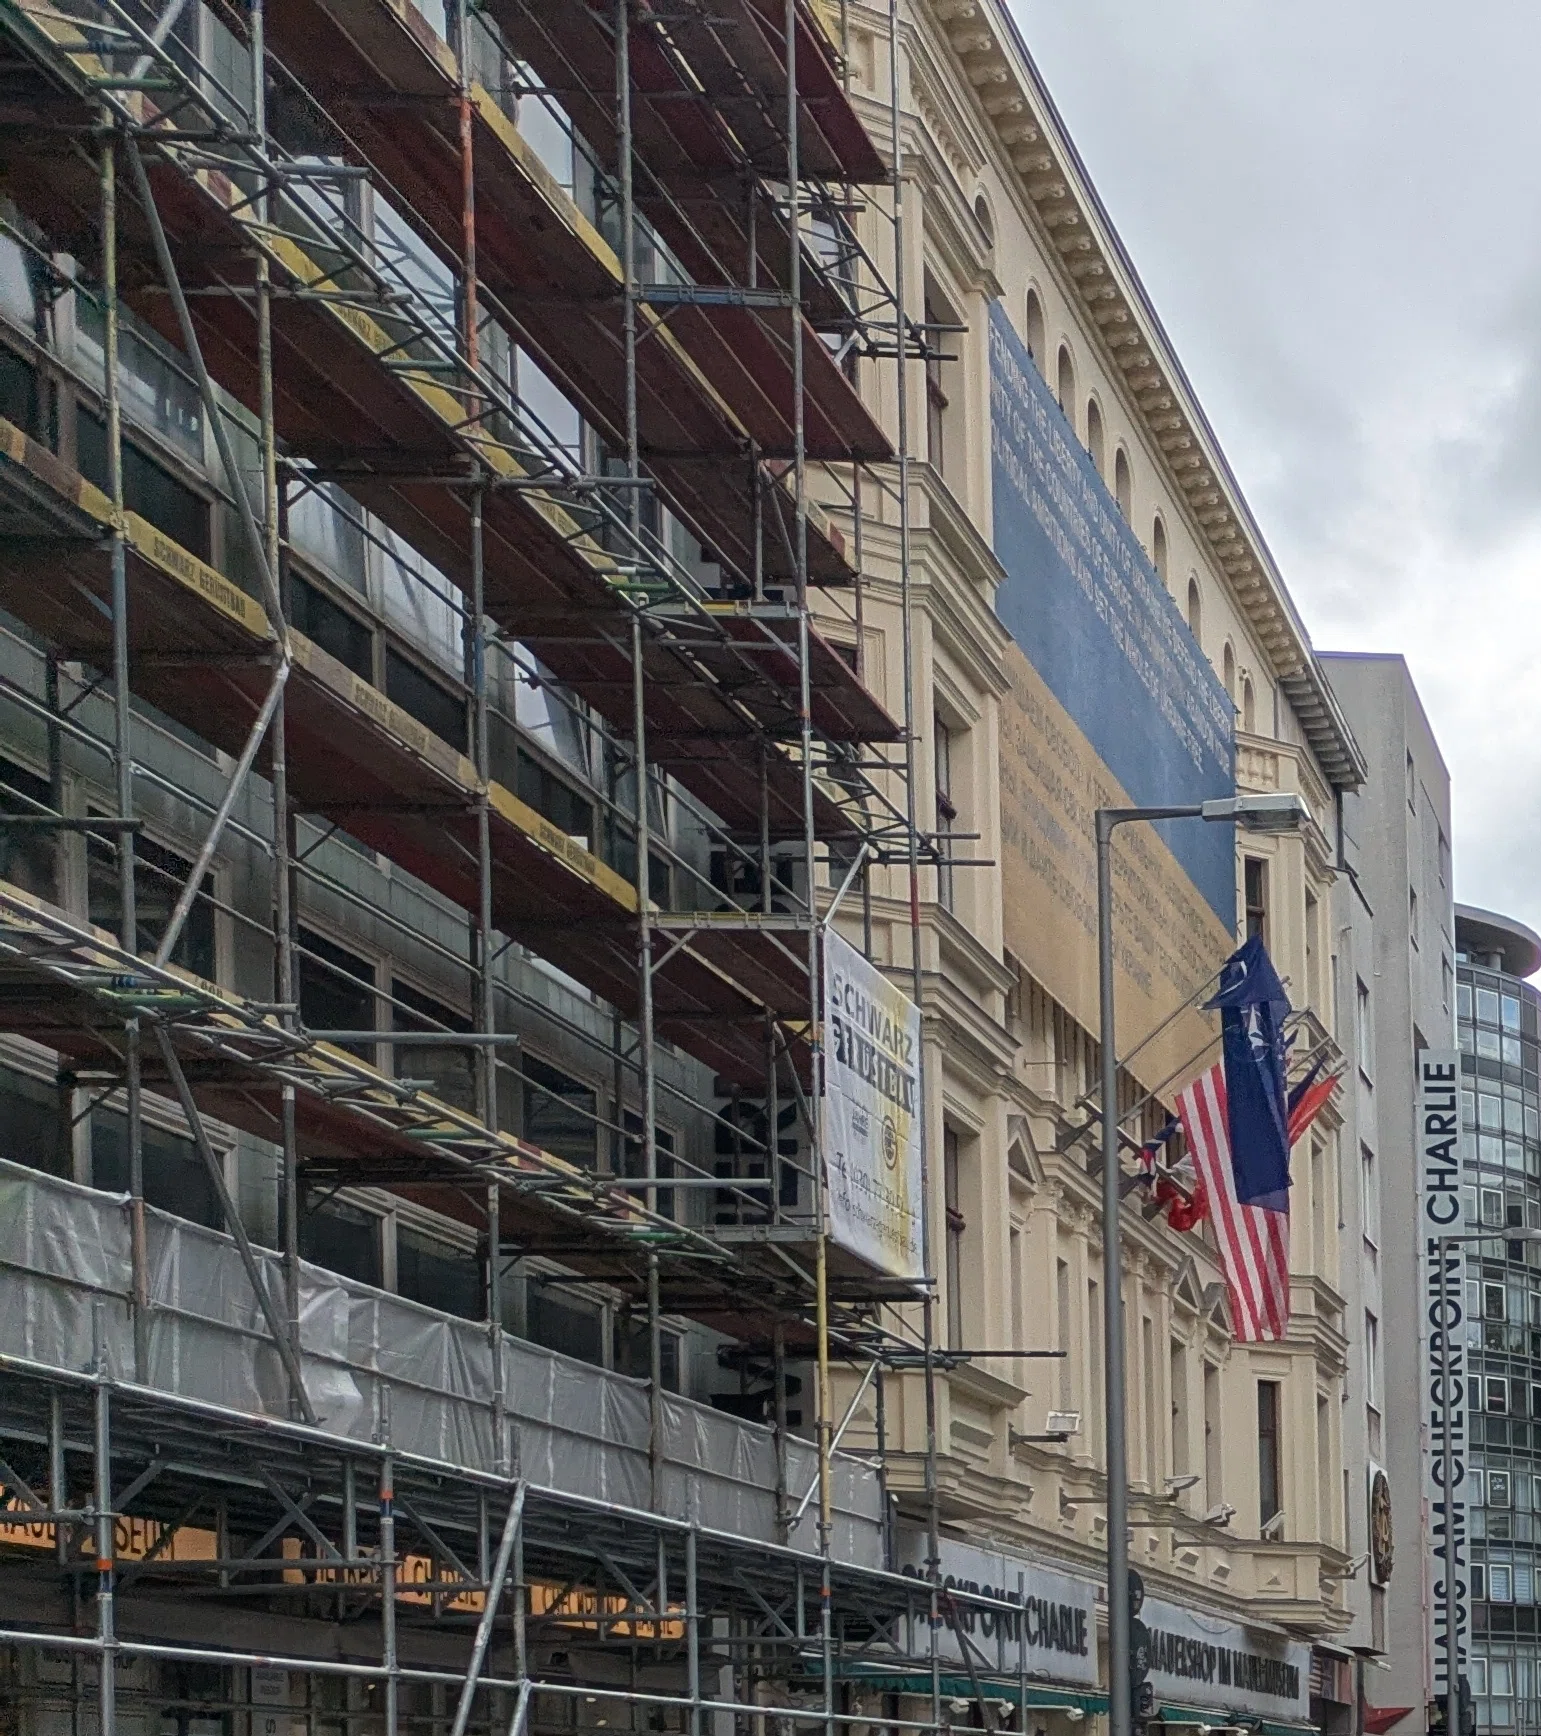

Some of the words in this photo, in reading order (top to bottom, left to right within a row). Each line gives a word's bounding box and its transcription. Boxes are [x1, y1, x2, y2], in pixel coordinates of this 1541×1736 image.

[832, 972, 914, 1068] SCHWARZ
[1423, 1061, 1461, 1226] CHARLIE
[1427, 1236, 1466, 1488] CHECKPOINT
[1432, 1501, 1467, 1567] AM
[1025, 1594, 1089, 1657] CHARLIE
